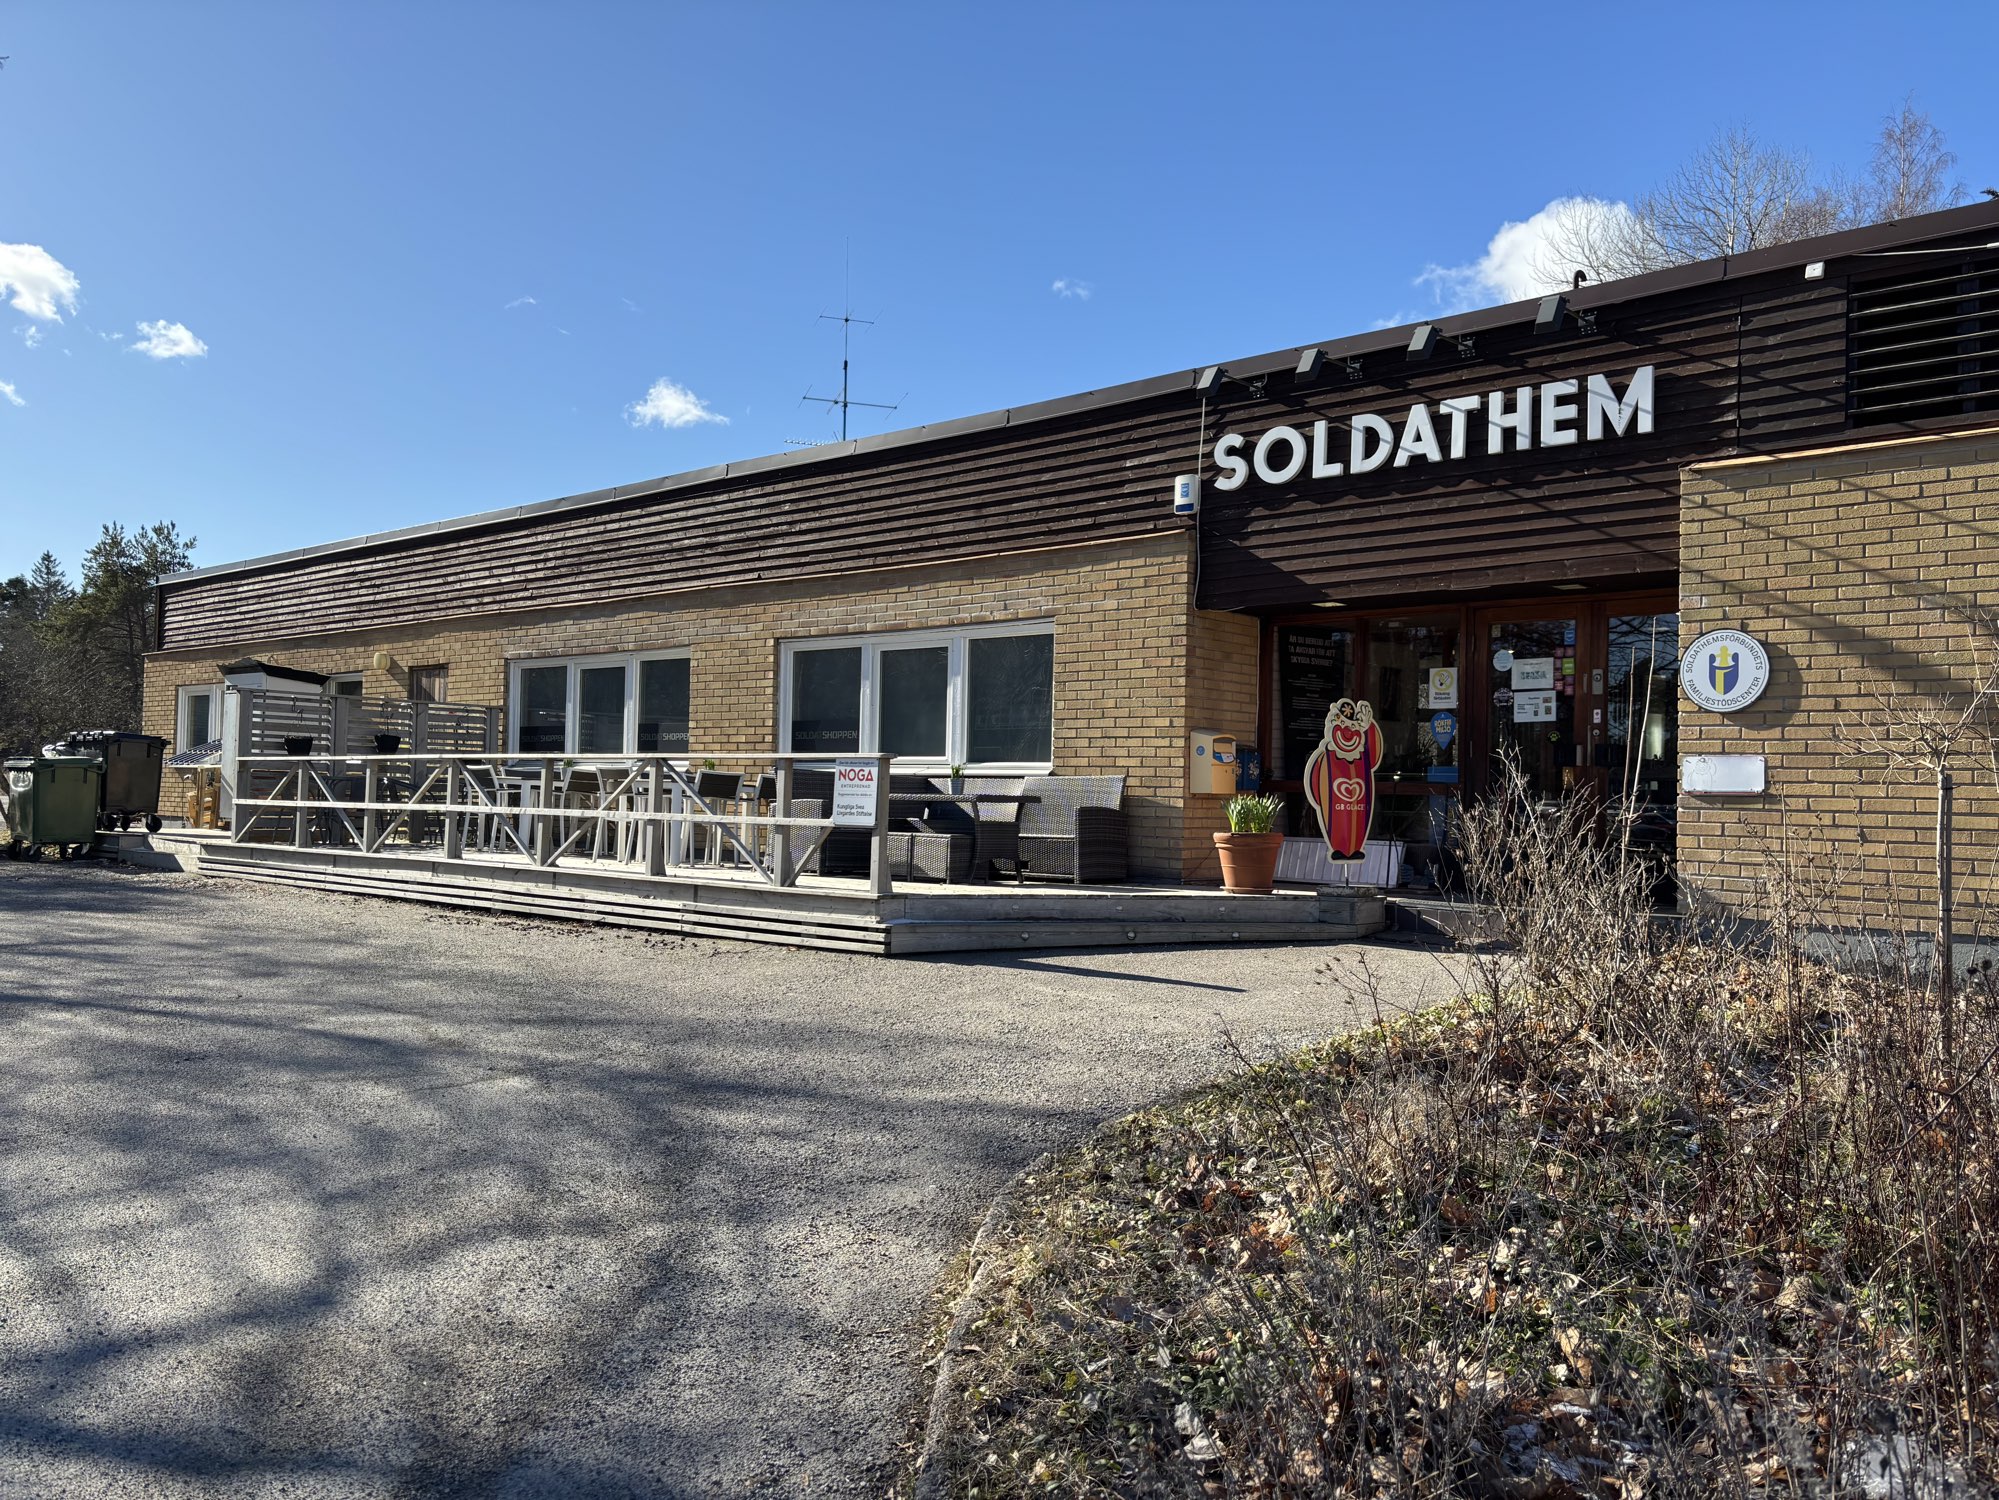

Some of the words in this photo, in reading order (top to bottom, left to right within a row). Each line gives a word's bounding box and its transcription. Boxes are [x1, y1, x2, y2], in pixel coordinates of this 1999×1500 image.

[1214, 365, 1655, 492] SOLDATHEM
[1685, 634, 1763, 673] SOLDATHEMSFÖRBUNDETS
[1686, 676, 1761, 706] FAMILJESTÖDSCENTER
[839, 769, 873, 781] NOGA
